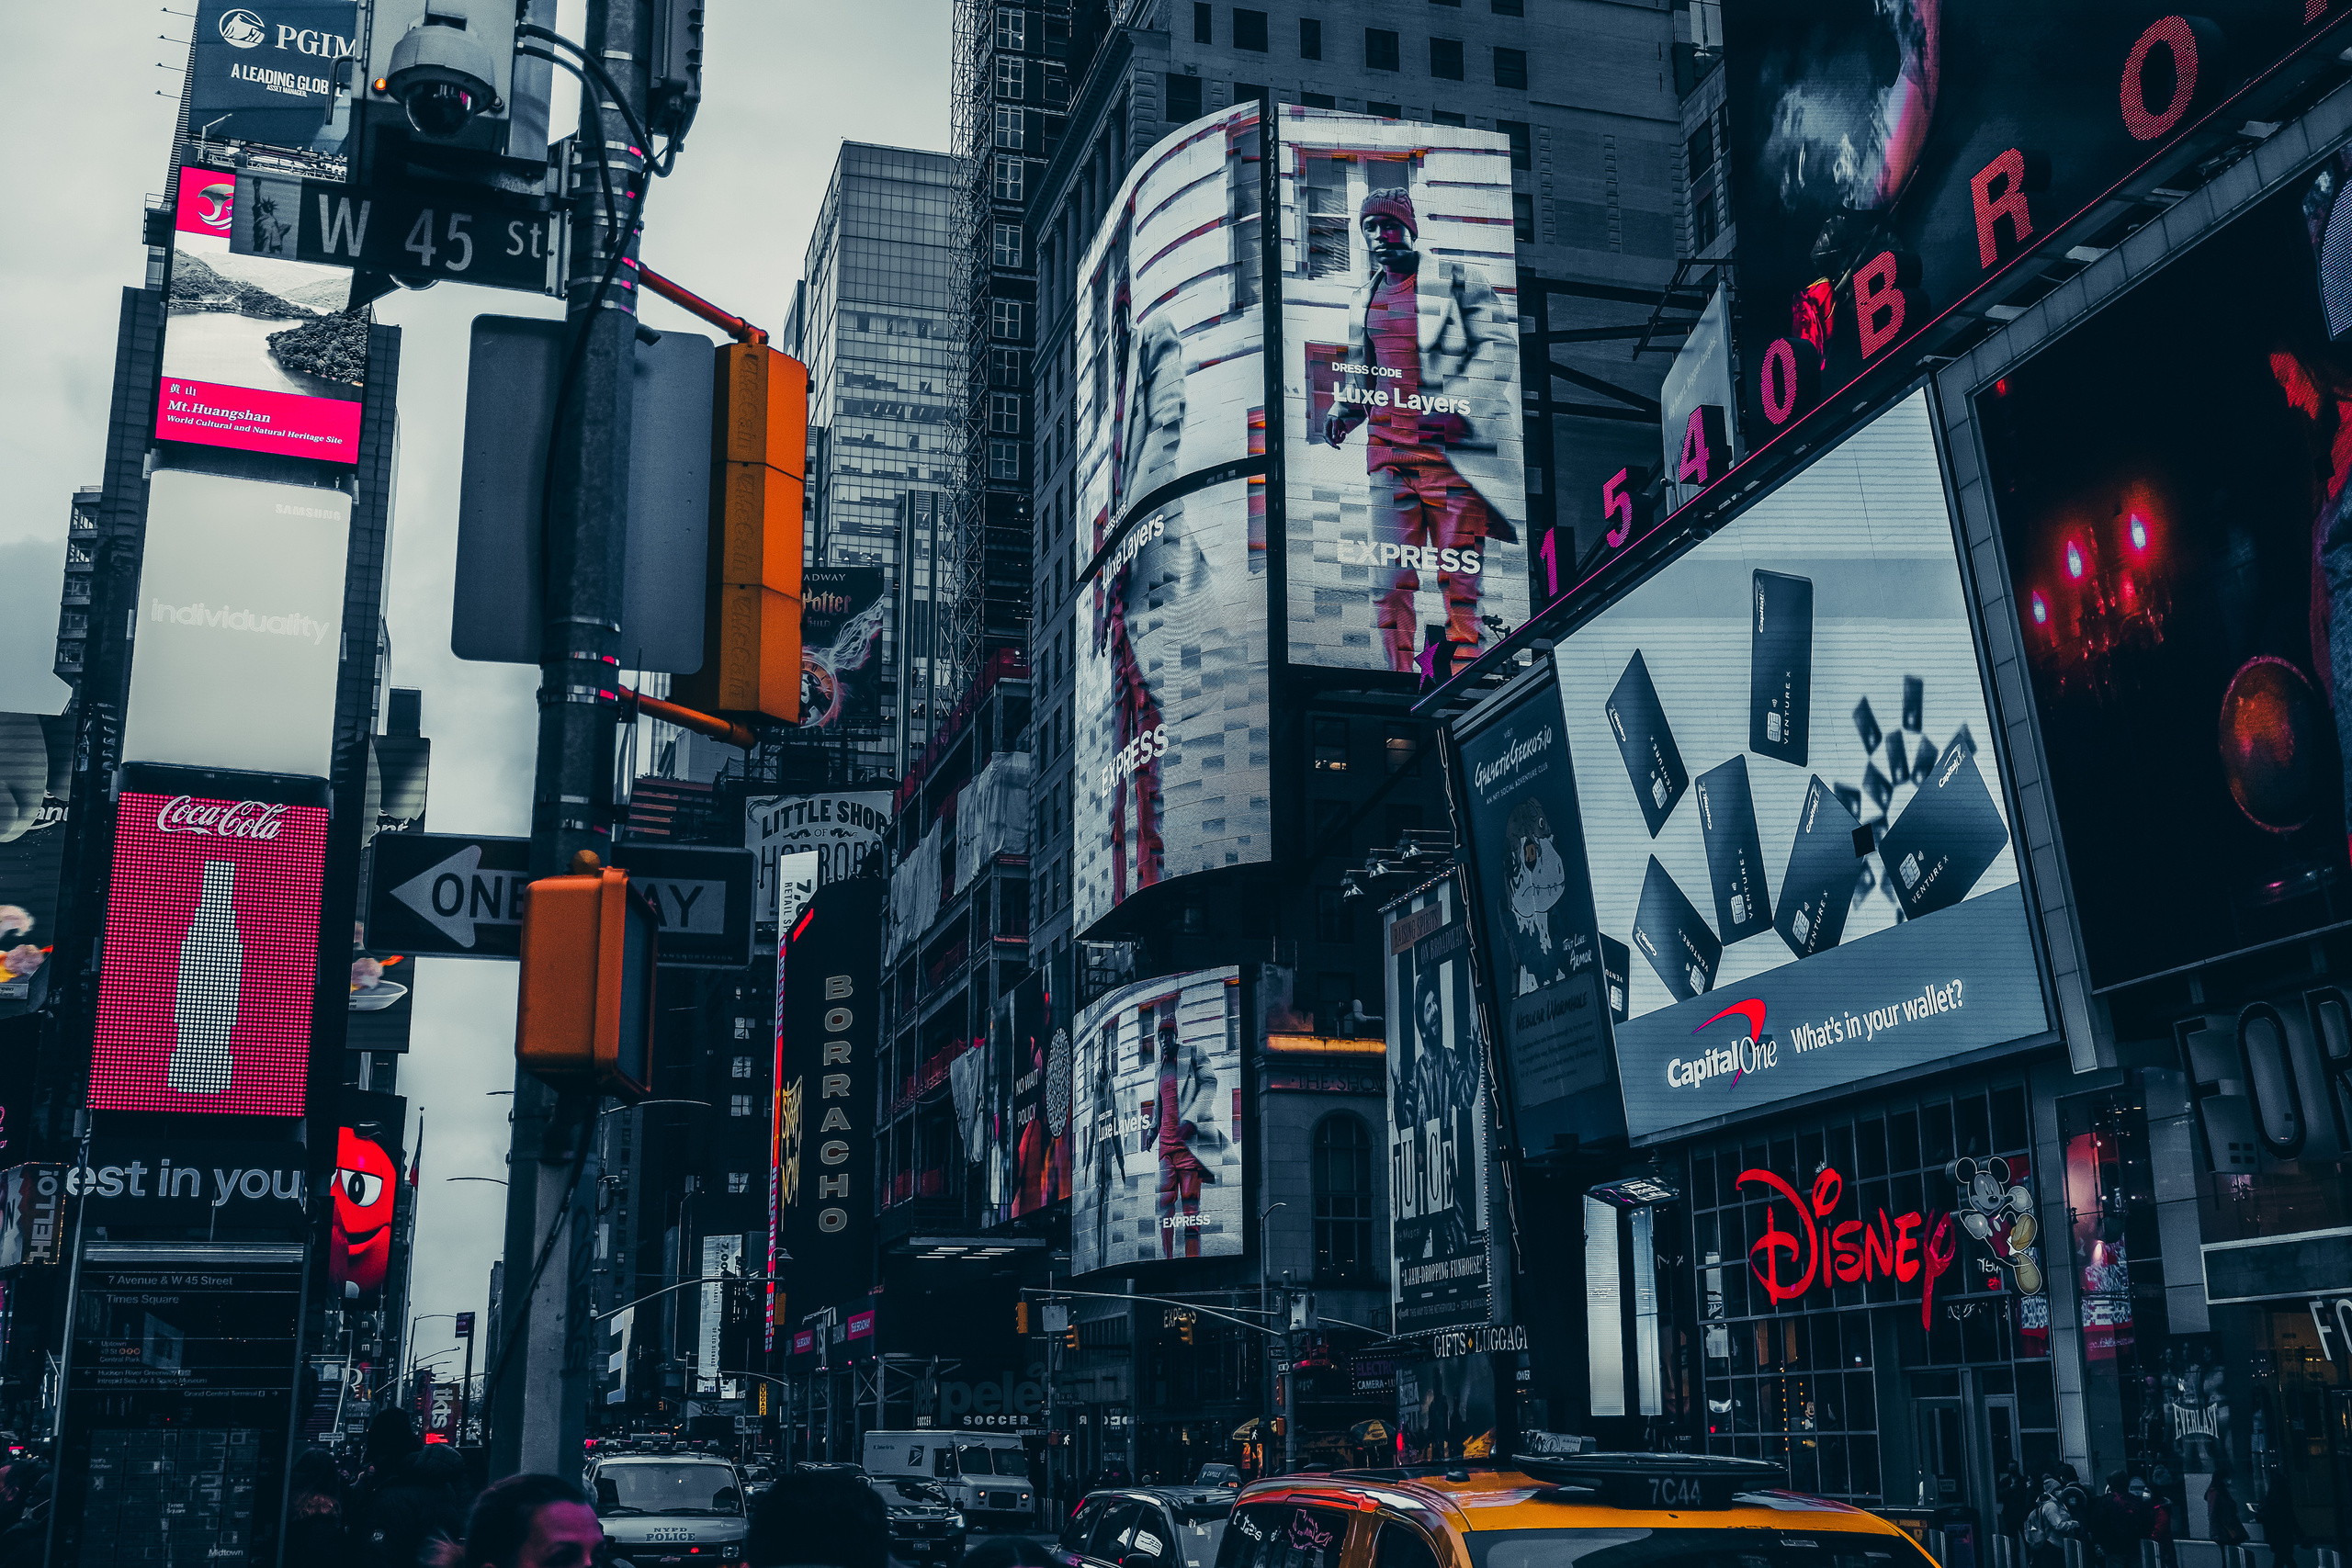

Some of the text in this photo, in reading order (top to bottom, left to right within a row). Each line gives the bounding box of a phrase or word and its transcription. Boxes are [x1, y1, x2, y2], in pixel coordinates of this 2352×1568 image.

[275, 24, 356, 59] PGIM
[231, 62, 344, 98] A LEADING GLOBL
[266, 84, 282, 93] ASSET
[1853, 0, 2329, 360] BRO
[319, 193, 542, 271] W 45 St
[1332, 362, 1403, 378] DRESS CODE
[167, 400, 271, 423] Mt.Huangshan
[1334, 381, 1471, 415] Luxe Layers
[166, 415, 343, 445] World Cultural and Natural Heritage Site
[276, 504, 341, 521] SAMSUNG
[1102, 514, 1165, 590] Luxe Layers
[1338, 539, 1481, 575] EXPRESS
[151, 597, 330, 646] individuality
[1102, 723, 1169, 798] EXPRESS
[1653, 743, 1673, 794] VENTURE
[156, 795, 289, 840] Coca-Cola
[762, 800, 831, 840] LITTLE
[814, 829, 828, 837] OF
[784, 882, 793, 916] RETAIL
[1739, 859, 1753, 919] VENTURE
[1912, 864, 1942, 904] VENTURE
[644, 884, 704, 928] AY
[1394, 909, 1440, 948] RAISING SPIRITS
[1420, 923, 1465, 964] ON BROADWAY!
[1807, 899, 1827, 953] VENTURE
[1682, 936, 1709, 972] VENTURE
[1791, 979, 1964, 1055] What's in your wallet?
[1024, 1068, 1039, 1092] WAIT
[1295, 1073, 1330, 1090] THE
[819, 974, 853, 1234] BORRACHO
[1018, 1102, 1037, 1127] POLICY
[1098, 1114, 1150, 1142] Luxe Layers
[159, 1159, 199, 1197] in
[214, 1168, 300, 1205] you
[29, 1169, 59, 1261] HELLO!
[1163, 1214, 1211, 1228] EXPRESS
[108, 1276, 233, 1285] 7 Avenue & W 45 Street
[107, 1294, 179, 1305] Times Square
[1163, 1307, 1196, 1328] EXPS
[1433, 1332, 1465, 1358] GIFTS
[143, 1370, 177, 1378] Greenway
[1357, 1379, 1384, 1390] CAMERA
[431, 1388, 454, 1429] tkts
[964, 1416, 1029, 1426] SOCCER
[2173, 1403, 2219, 1440] EVERLAST
[1648, 1477, 1702, 1506] 7C44
[208, 1549, 243, 1557] Midtown
[646, 1532, 696, 1541] POLICE
